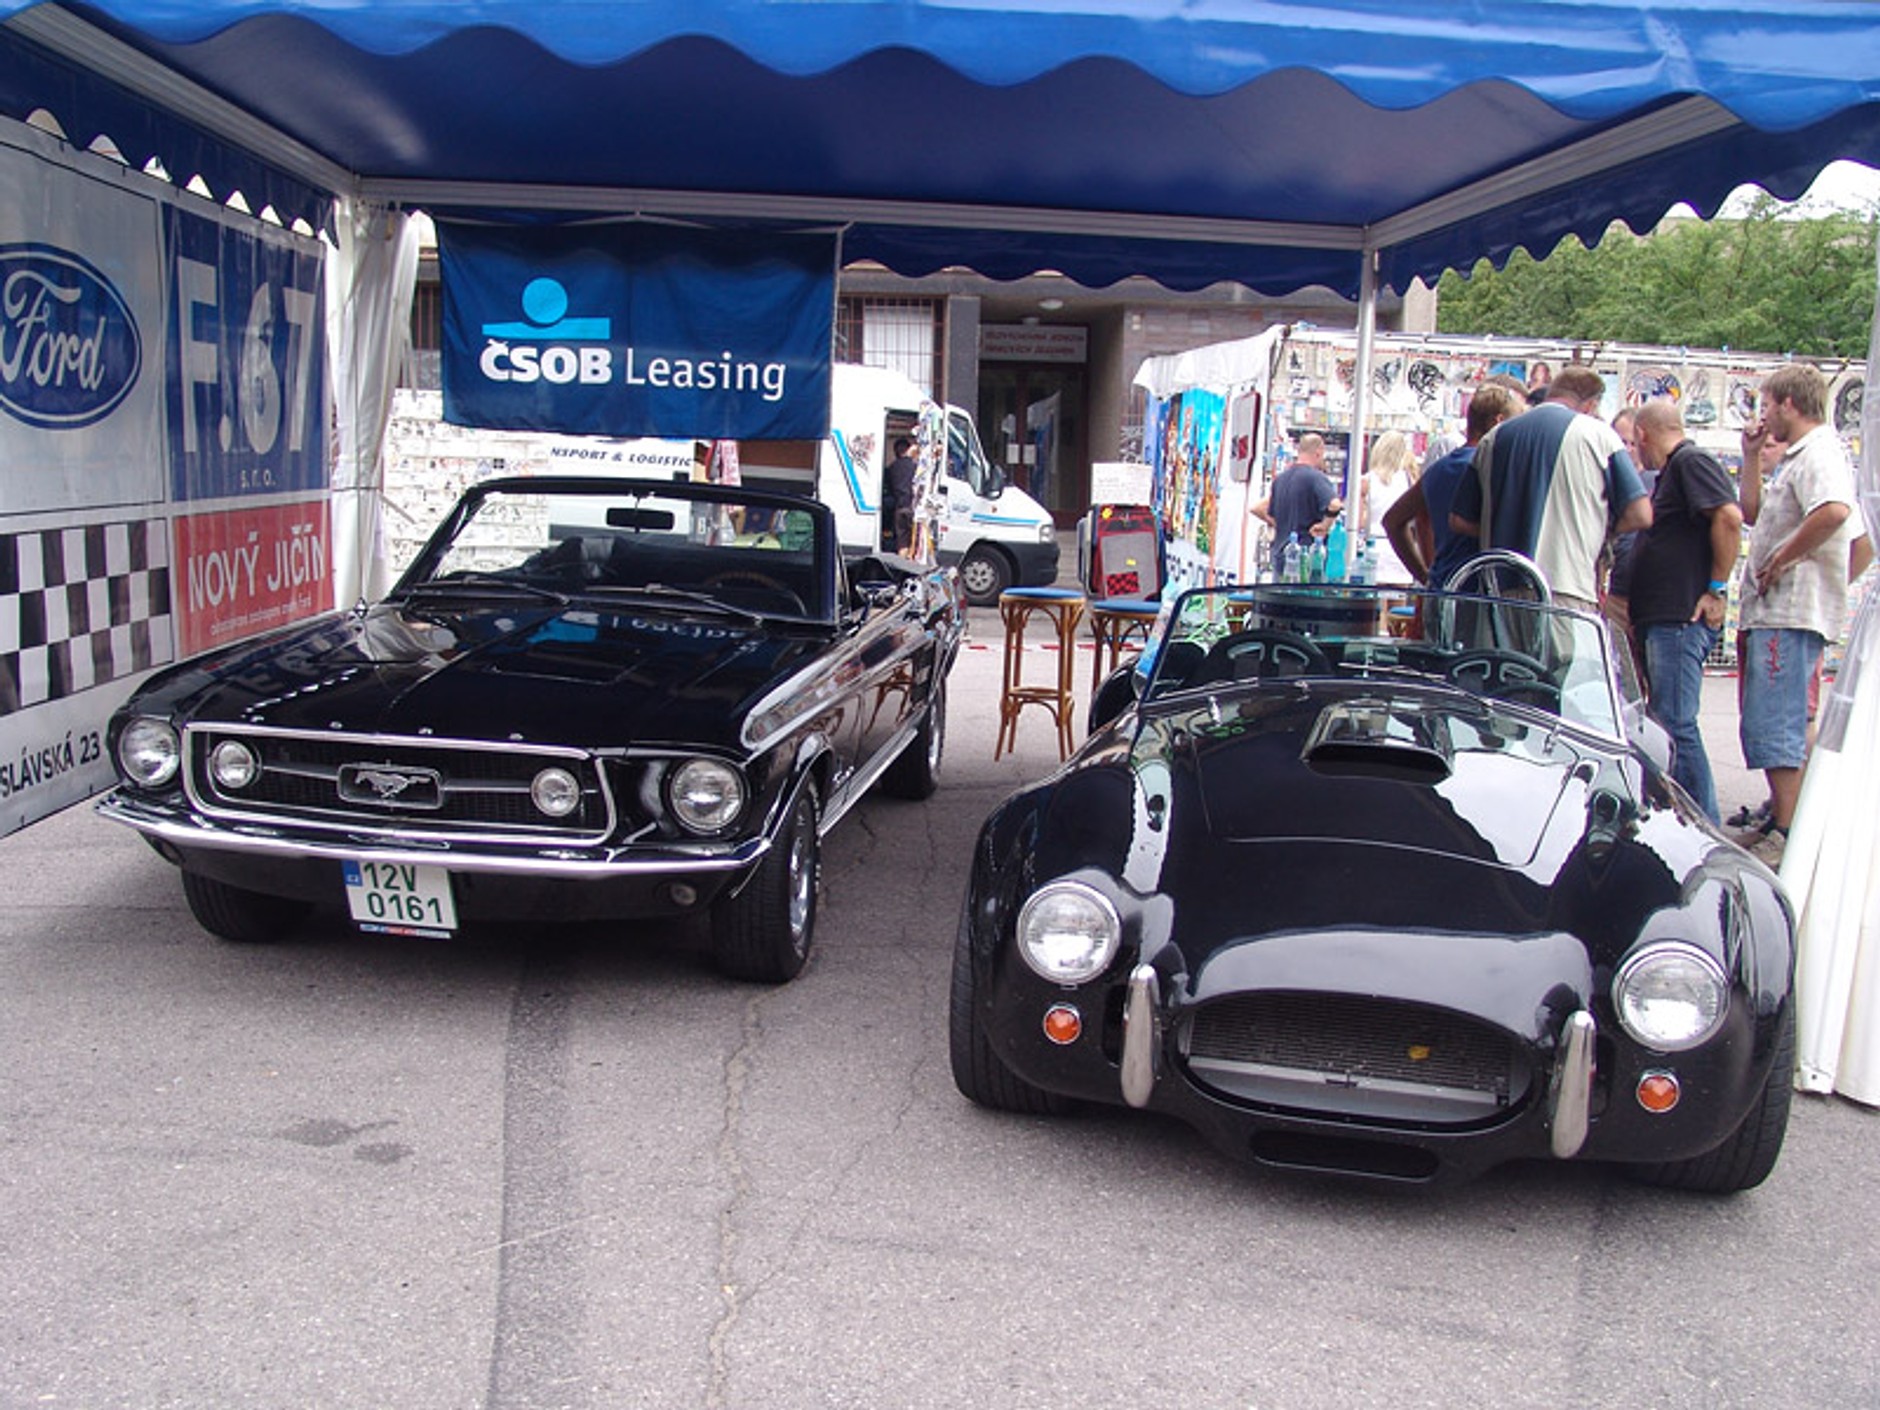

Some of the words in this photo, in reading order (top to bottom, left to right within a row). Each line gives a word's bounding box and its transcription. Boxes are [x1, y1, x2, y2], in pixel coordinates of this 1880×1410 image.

[0, 270, 106, 390] Ford
[480, 338, 612, 384] ČSOB
[626, 347, 786, 401] Leasing
[188, 531, 260, 614] NOVÝ
[267, 523, 326, 592] JIČÍN
[0, 730, 74, 798] SLÁVSKÁ
[80, 731, 100, 764] 23
[364, 862, 416, 892] 12V
[367, 891, 442, 923] 0161
